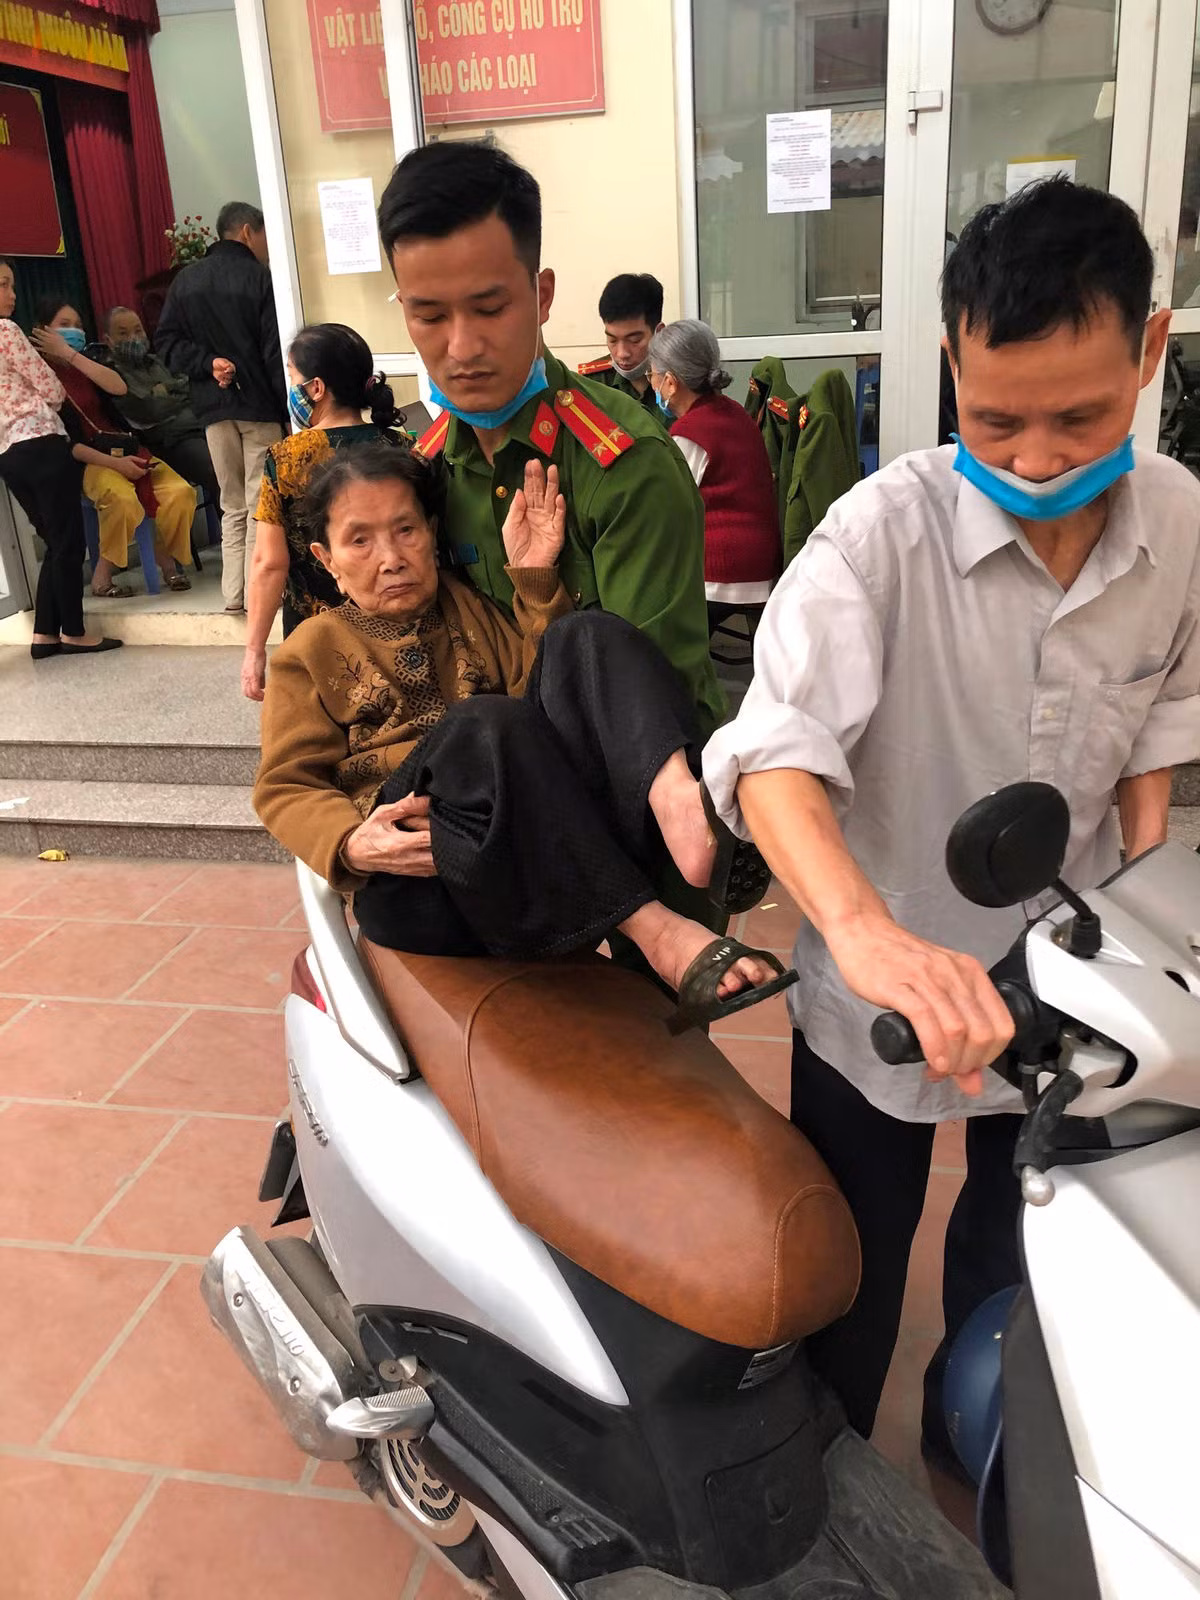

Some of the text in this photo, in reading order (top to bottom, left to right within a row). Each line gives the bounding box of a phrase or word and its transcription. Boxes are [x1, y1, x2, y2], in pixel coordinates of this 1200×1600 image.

[323, 7, 355, 56] VẬT
[437, 0, 488, 38] CÔNG
[491, 0, 516, 39] CỤ
[418, 55, 454, 97] HÁO
[457, 51, 493, 93] CÁC
[496, 52, 538, 95] LOẠI
[712, 946, 731, 962] VIP
